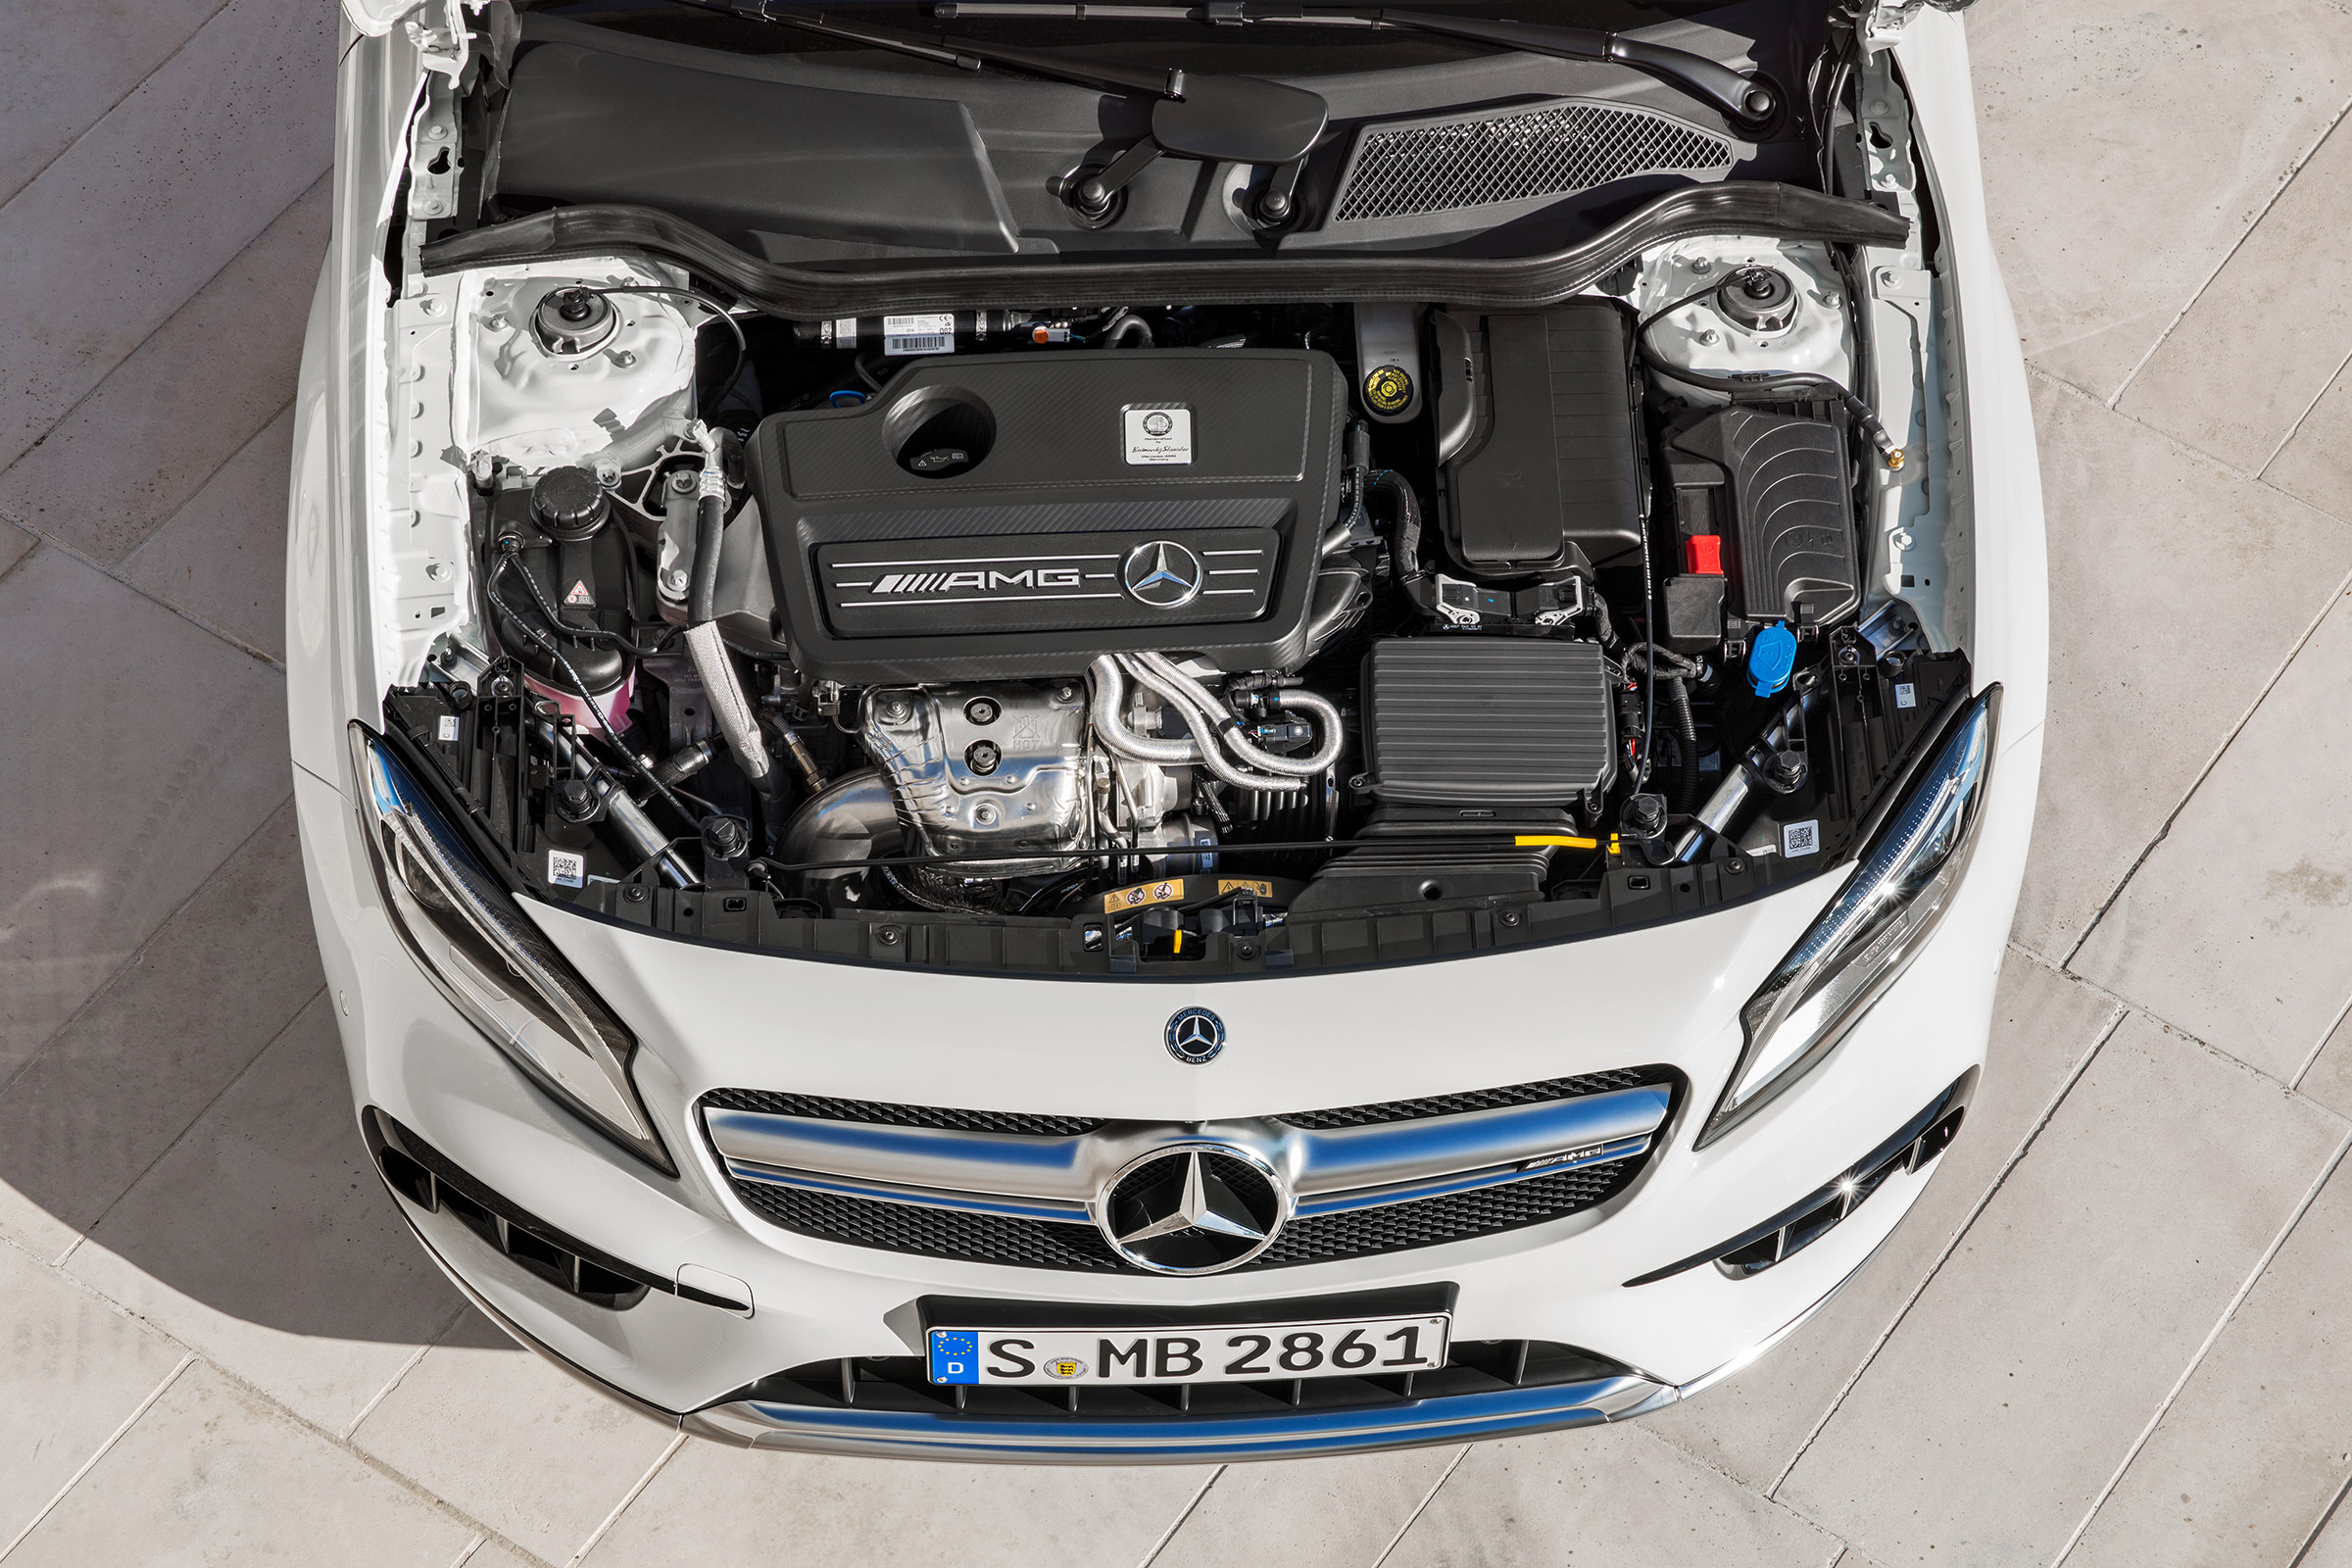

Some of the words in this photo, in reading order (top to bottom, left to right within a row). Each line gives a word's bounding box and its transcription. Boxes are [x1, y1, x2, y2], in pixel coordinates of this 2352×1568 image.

[939, 567, 1081, 593] AMG
[1177, 1008, 1216, 1021] MERCEDES
[987, 1339, 1036, 1378] S
[1098, 1337, 1203, 1379] MB
[1223, 1326, 1429, 1375] 2861
[947, 1361, 964, 1374] D
